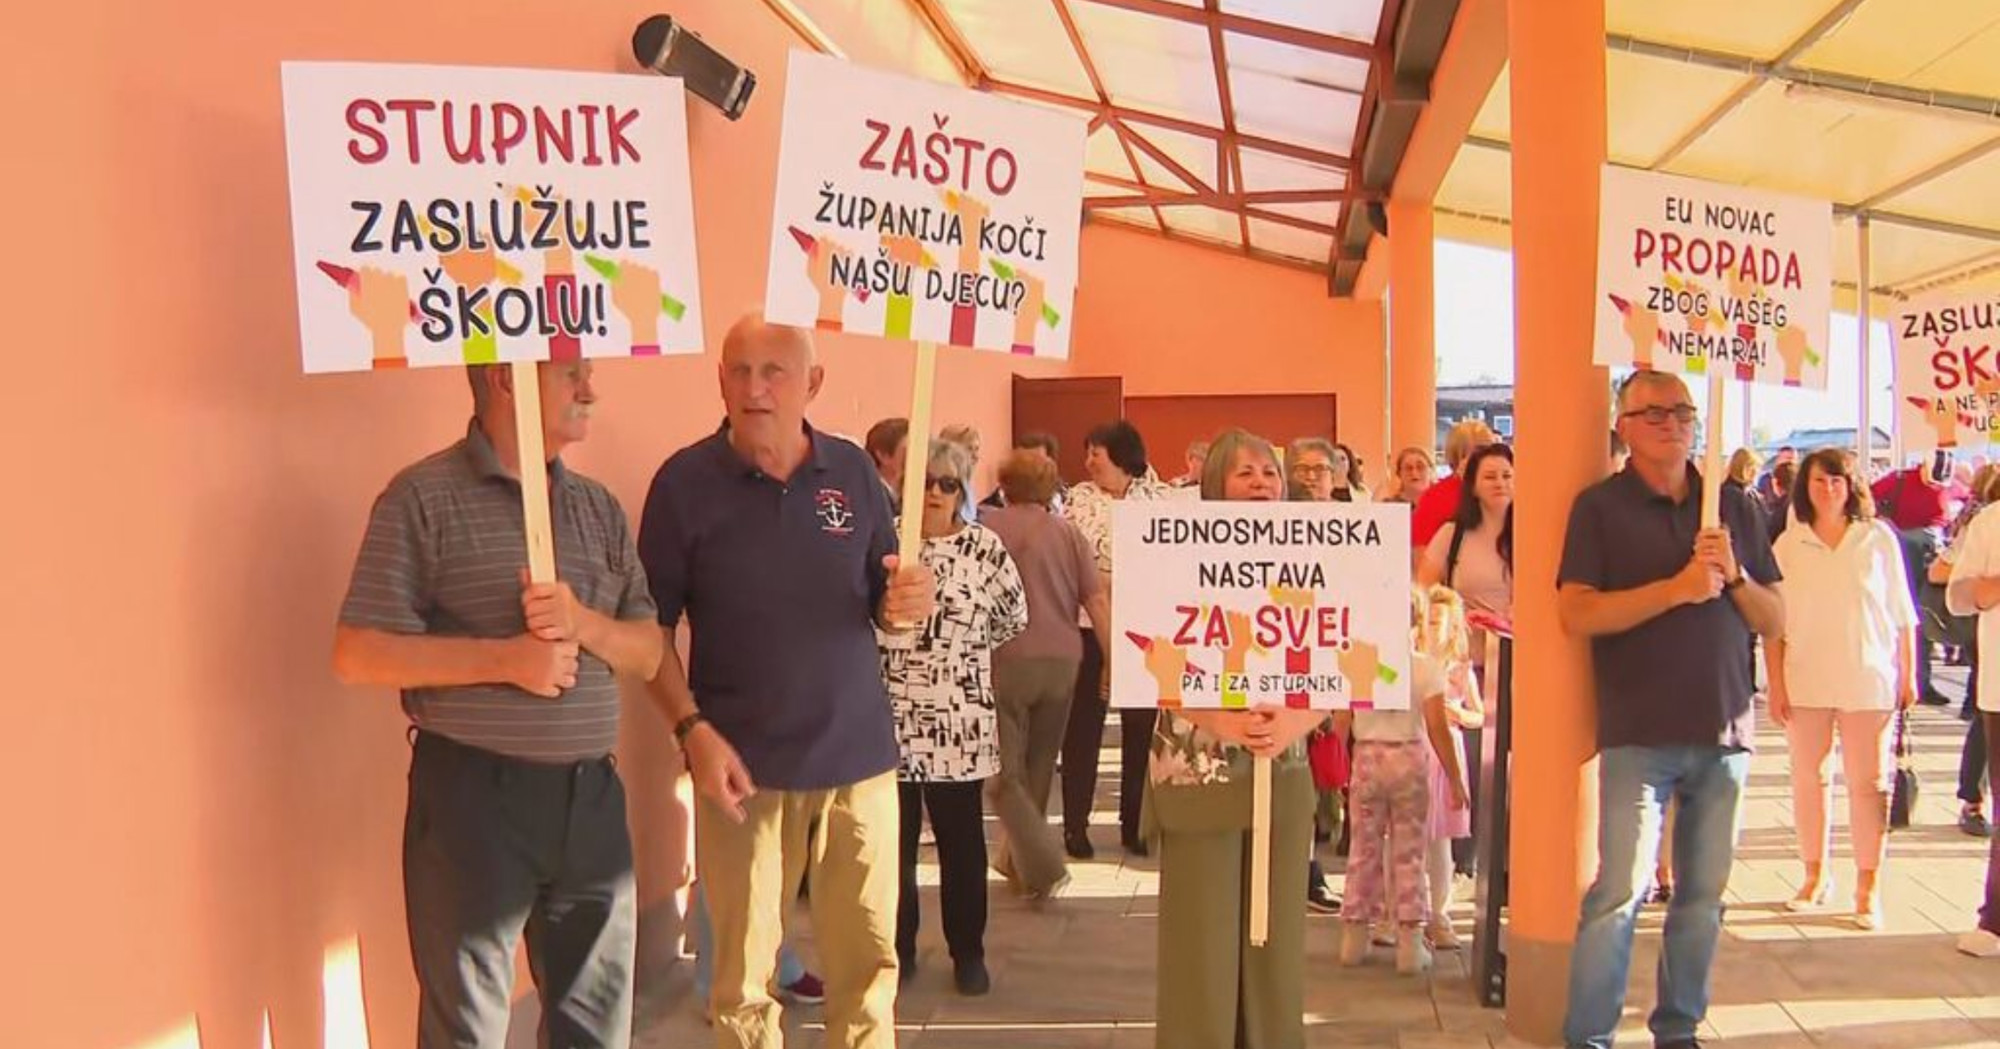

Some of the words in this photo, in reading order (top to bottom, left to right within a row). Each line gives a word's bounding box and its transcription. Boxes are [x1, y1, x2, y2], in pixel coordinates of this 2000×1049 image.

[344, 98, 642, 166] STUPNIK
[859, 112, 1017, 196] ZAŠTO
[350, 184, 651, 254] ZASLUŽUJE
[815, 180, 963, 247] ŽUPANIJA
[978, 215, 1047, 261] KOČI
[1665, 197, 1693, 224] EU
[1705, 203, 1777, 237] NOVAC
[829, 248, 911, 297] NAŠU
[925, 270, 1026, 316] DJECU?
[1634, 228, 1802, 290] PROPADA
[418, 267, 608, 343] ŠKOLU!
[1647, 286, 1709, 317] ZBOG
[1901, 301, 2000, 340] ZASLU
[1668, 332, 1767, 367] NEMARA!
[1931, 335, 2000, 391] ŠK
[1142, 518, 1381, 546] JEDNOSMJENSKA
[1199, 561, 1326, 589] NASTAVA
[1173, 605, 1230, 648] ZA
[1255, 605, 1350, 650] SVE!
[1182, 674, 1204, 692] PA
[1213, 674, 1220, 692] I
[1228, 674, 1250, 692] ZA
[1259, 674, 1343, 693] STUPNIK!
